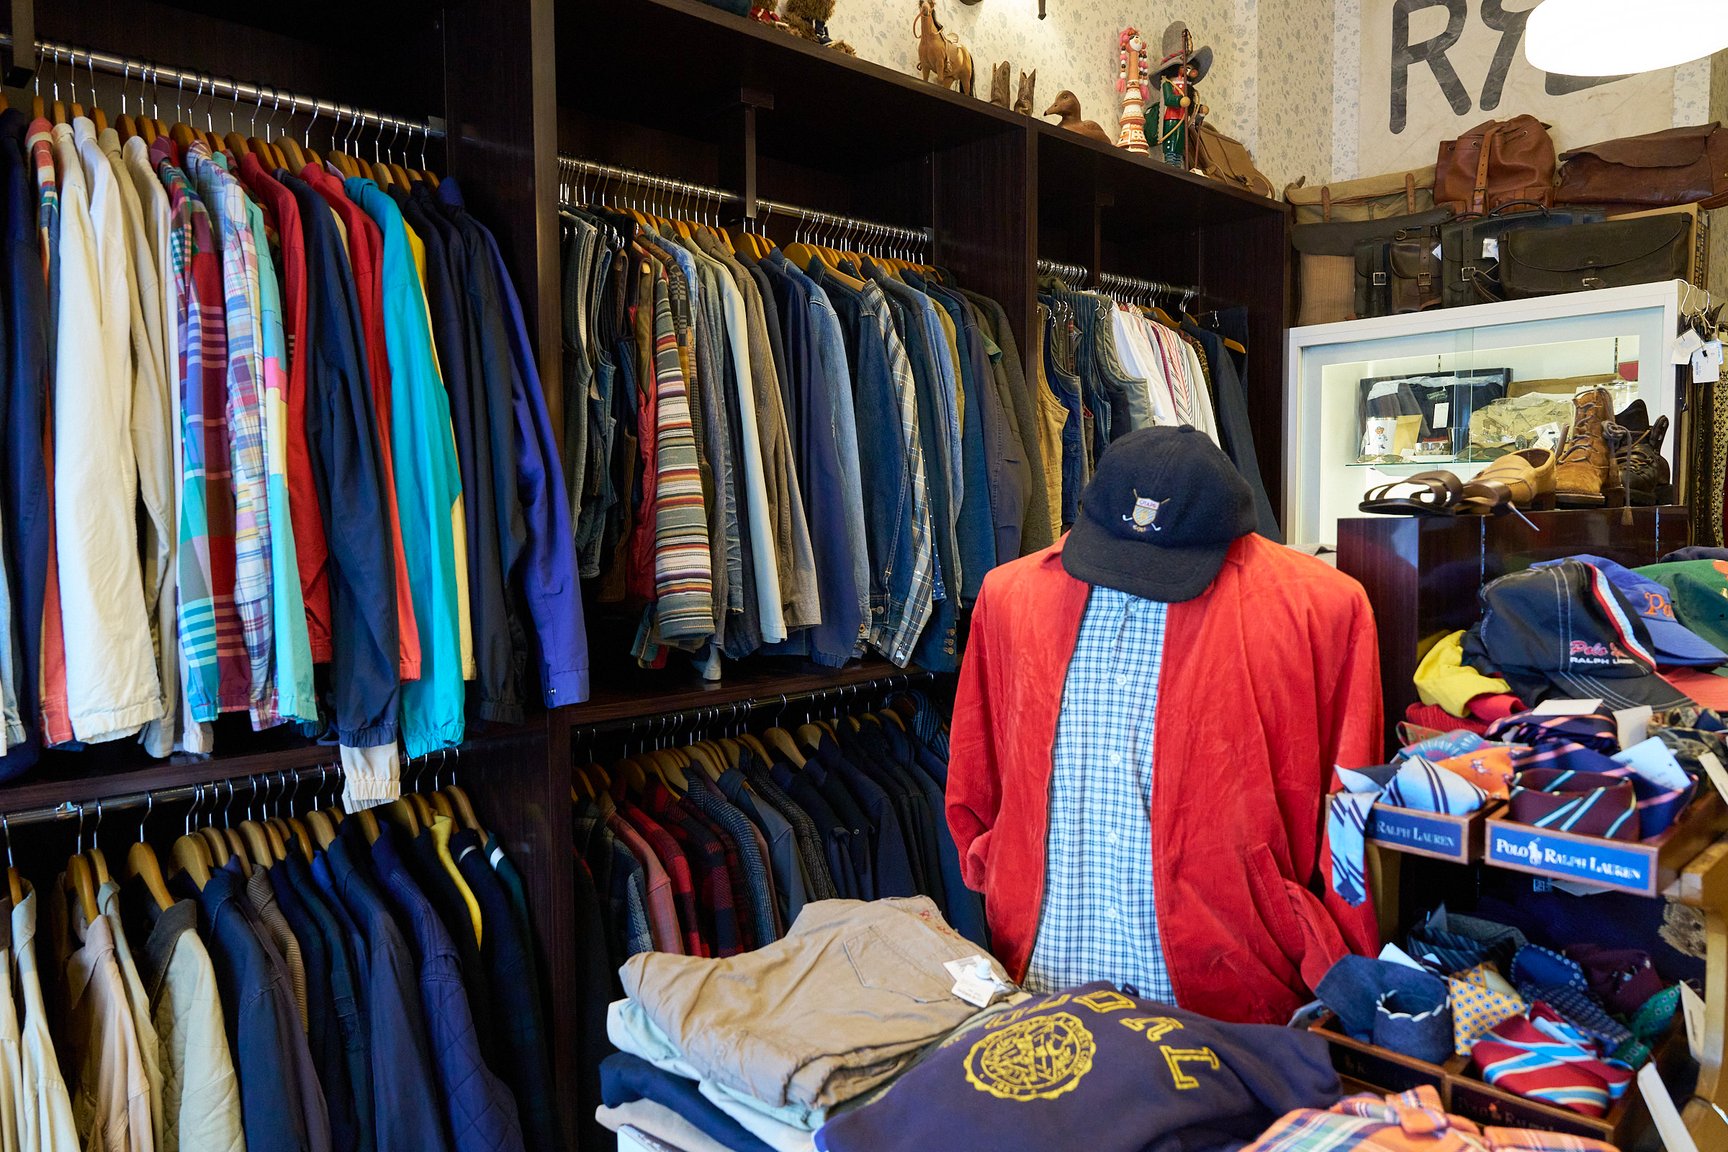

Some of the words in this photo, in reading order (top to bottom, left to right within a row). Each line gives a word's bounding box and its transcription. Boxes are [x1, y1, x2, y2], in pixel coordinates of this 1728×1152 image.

[1569, 640, 1608, 656] Polo
[1569, 657, 1609, 665] RALPH
[1376, 820, 1411, 839] RALPH
[1413, 827, 1455, 848] LAUREN
[1496, 838, 1529, 858] POLO
[1544, 848, 1587, 869] RALPH
[1590, 856, 1642, 880] LAUREN
